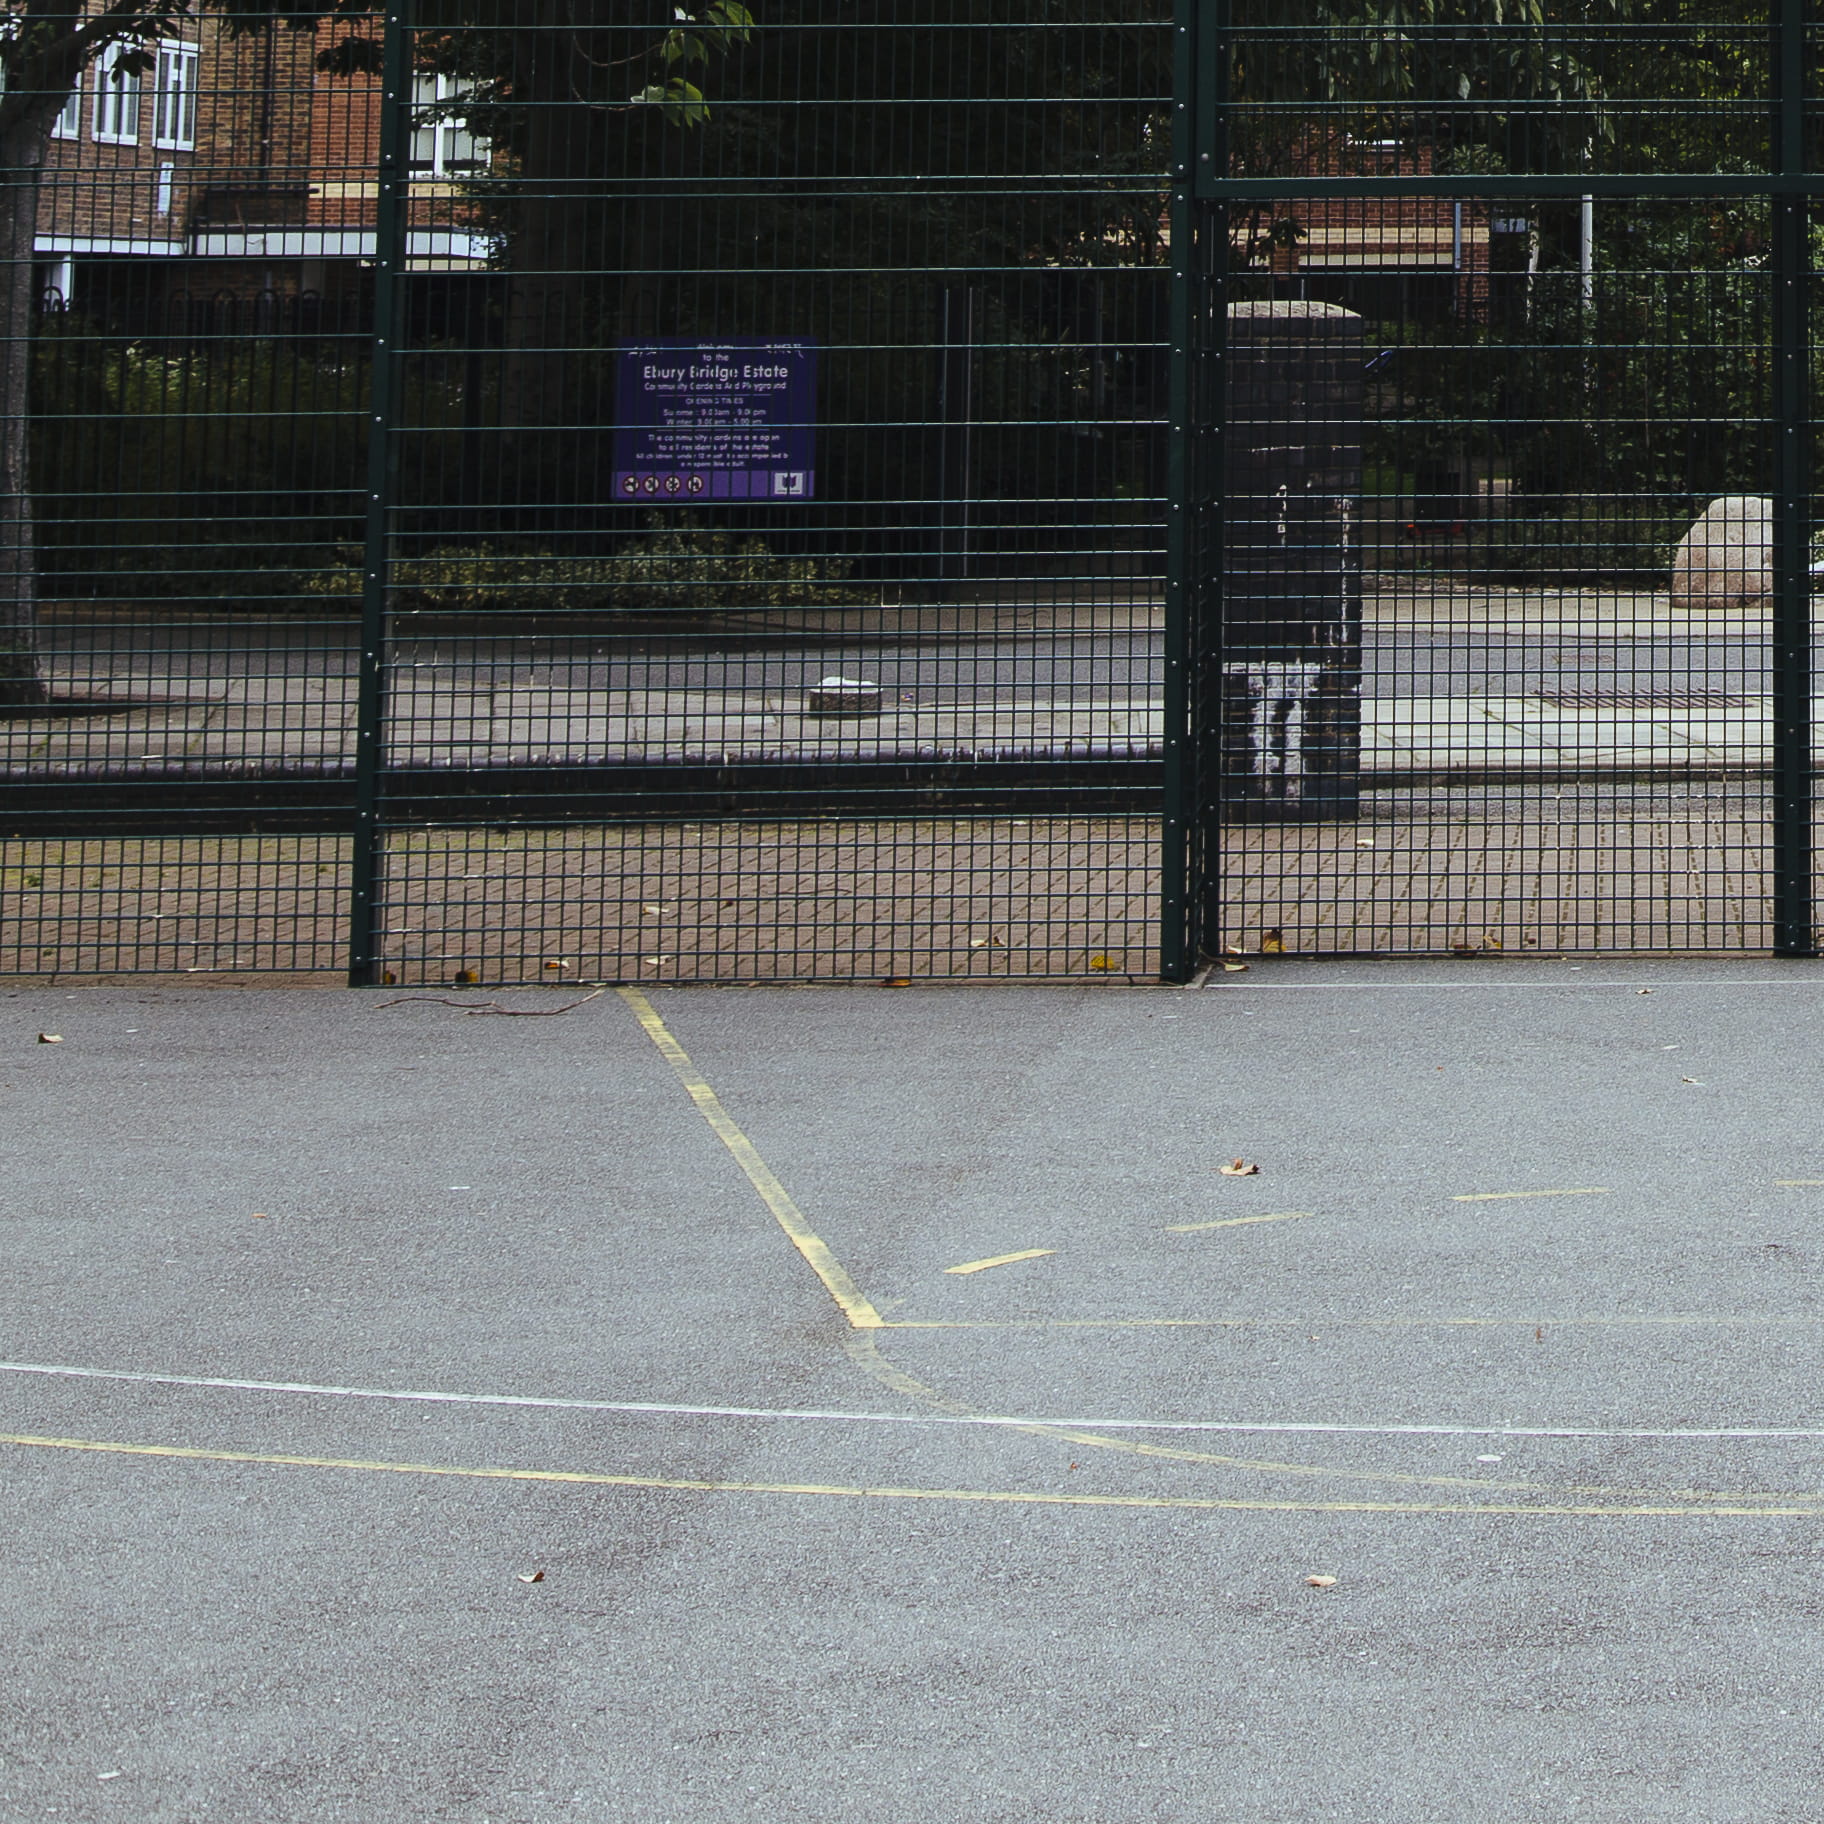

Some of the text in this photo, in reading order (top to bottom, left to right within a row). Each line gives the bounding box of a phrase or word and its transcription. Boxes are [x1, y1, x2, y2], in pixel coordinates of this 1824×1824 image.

[702, 353, 730, 362] to the
[643, 365, 789, 382] Ebury Bridge Estate
[644, 382, 688, 392] Commuity
[742, 382, 787, 392] Plyground
[664, 434, 708, 442] commuity
